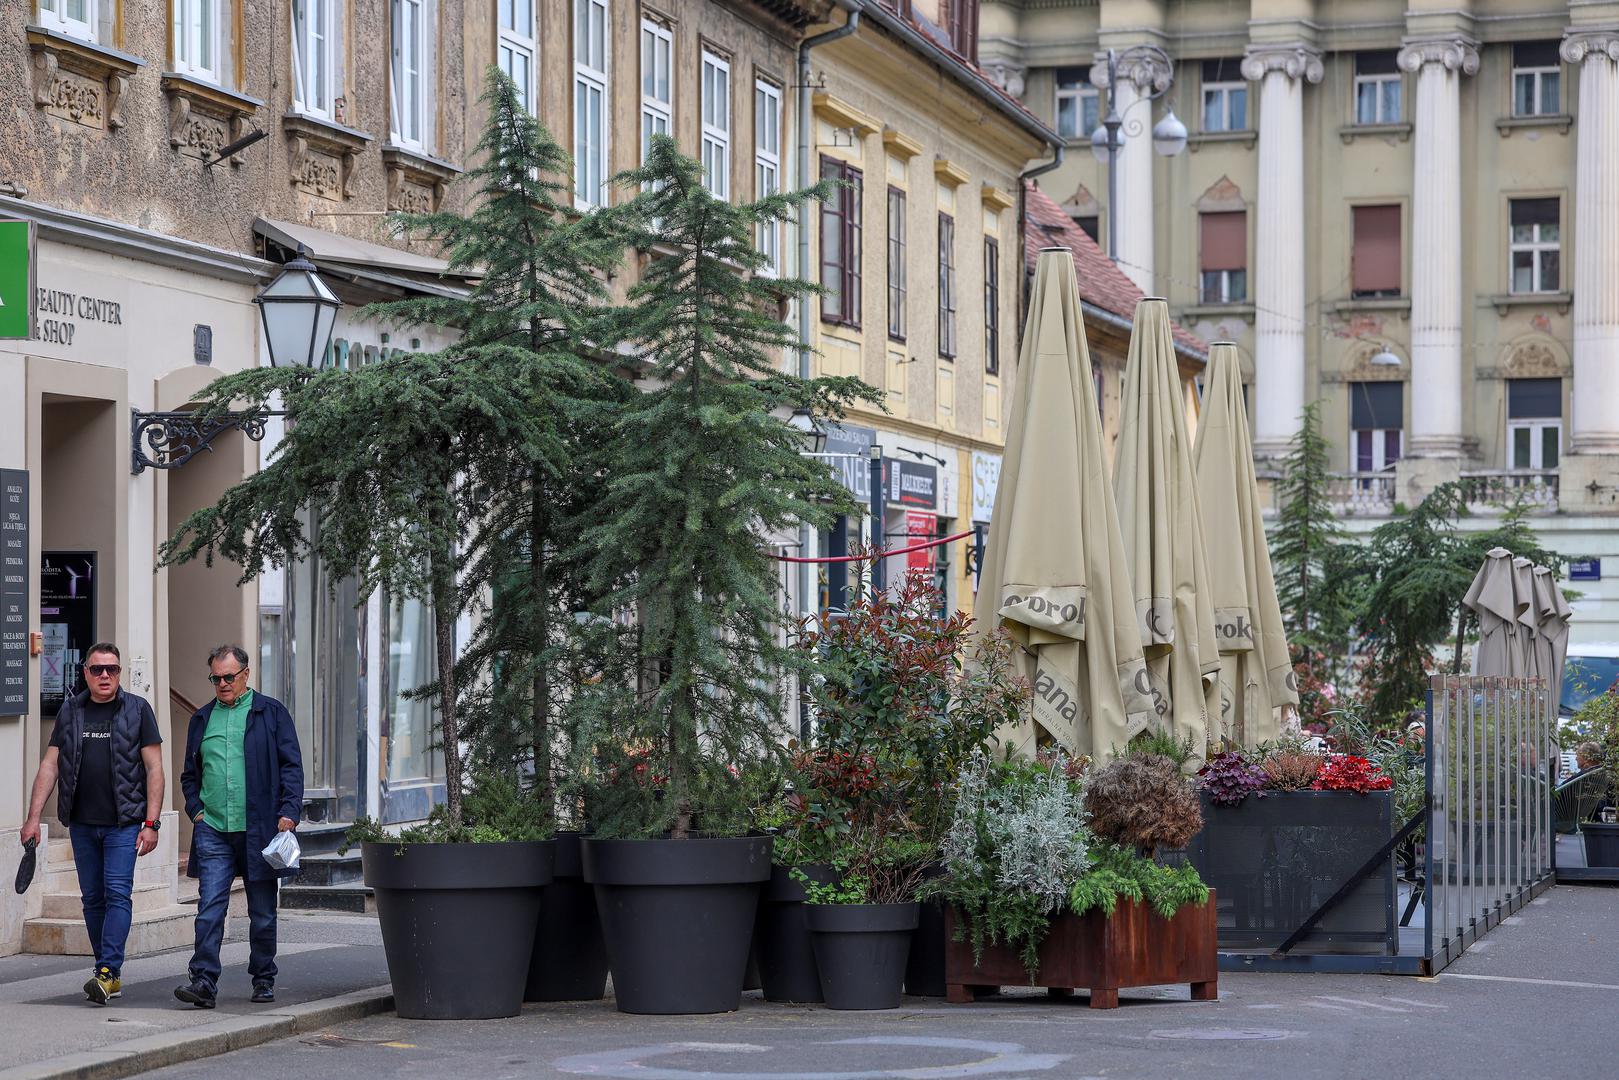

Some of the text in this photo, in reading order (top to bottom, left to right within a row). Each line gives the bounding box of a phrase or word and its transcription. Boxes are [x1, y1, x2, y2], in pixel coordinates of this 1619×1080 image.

[78, 296, 122, 325] CENTER
[43, 319, 75, 346] SHOP
[6, 557, 23, 565] PEDIKURA
[5, 574, 24, 583] MANIKURA
[6, 614, 22, 622] ANALYSIS
[3, 642, 26, 650] TREATMENTS
[6, 659, 22, 667] MASSAGE
[5, 677, 23, 685] PEDICURE
[4, 694, 24, 703] MANICURE
